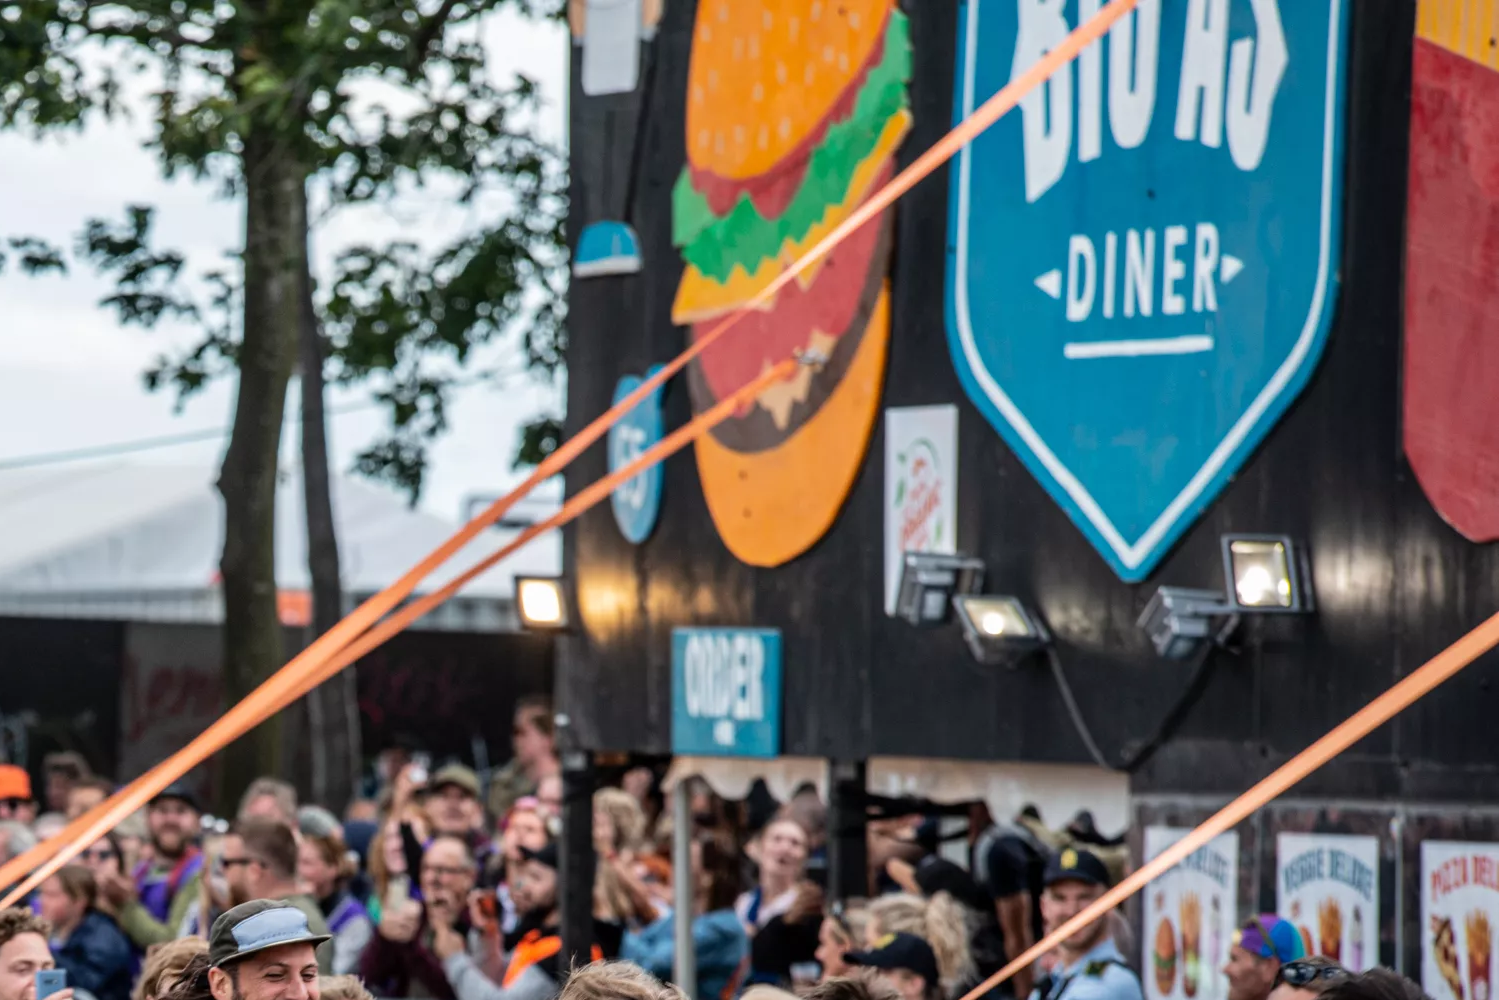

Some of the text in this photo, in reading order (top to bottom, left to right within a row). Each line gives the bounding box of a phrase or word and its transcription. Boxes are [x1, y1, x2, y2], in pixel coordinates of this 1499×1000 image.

[1065, 222, 1220, 322] DINER
[684, 634, 764, 721] ORDER
[1430, 856, 1469, 904] PIZZA
